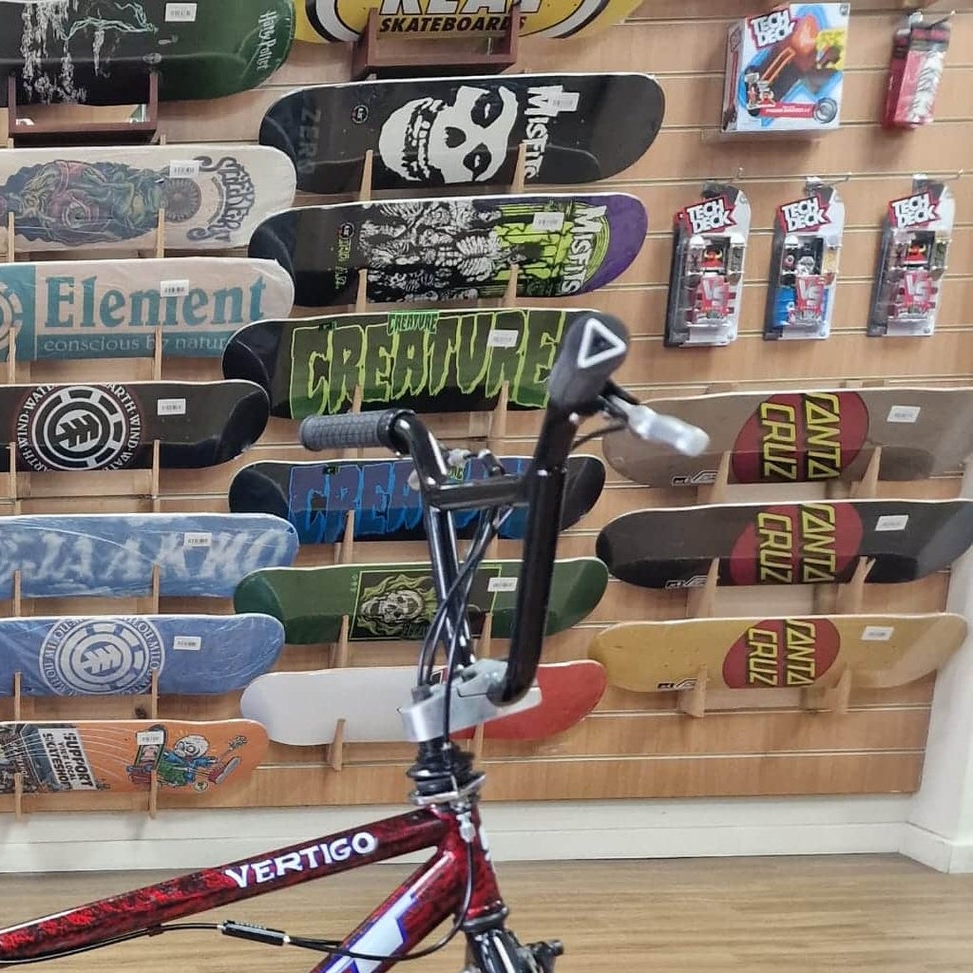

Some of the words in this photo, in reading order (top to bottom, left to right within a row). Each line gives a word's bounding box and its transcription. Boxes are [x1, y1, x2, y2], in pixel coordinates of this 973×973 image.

[750, 10, 790, 34] TECH
[756, 22, 796, 49] DECK
[686, 197, 725, 220] TECH
[692, 211, 733, 233] DECK
[780, 197, 819, 220] TECH
[787, 211, 828, 233] DECK
[893, 193, 932, 217] TECH
[897, 205, 938, 229] DECK
[561, 205, 607, 293] MISFITS
[45, 275, 267, 328] Element
[388, 312, 439, 335] CREATURE
[44, 336, 139, 352] conscious
[176, 337, 234, 352] natur
[289, 310, 567, 419] CREATURE
[760, 402, 797, 480] CRUZ
[805, 392, 842, 480] SANTA
[757, 511, 793, 584] CRUZ
[801, 503, 836, 583] SANTA
[747, 628, 778, 686] CRUZ
[786, 618, 816, 686] SANTA
[43, 733, 72, 789] SKATESHOP
[64, 732, 93, 787] SUPPORT
[224, 832, 378, 889] VERTIGO
